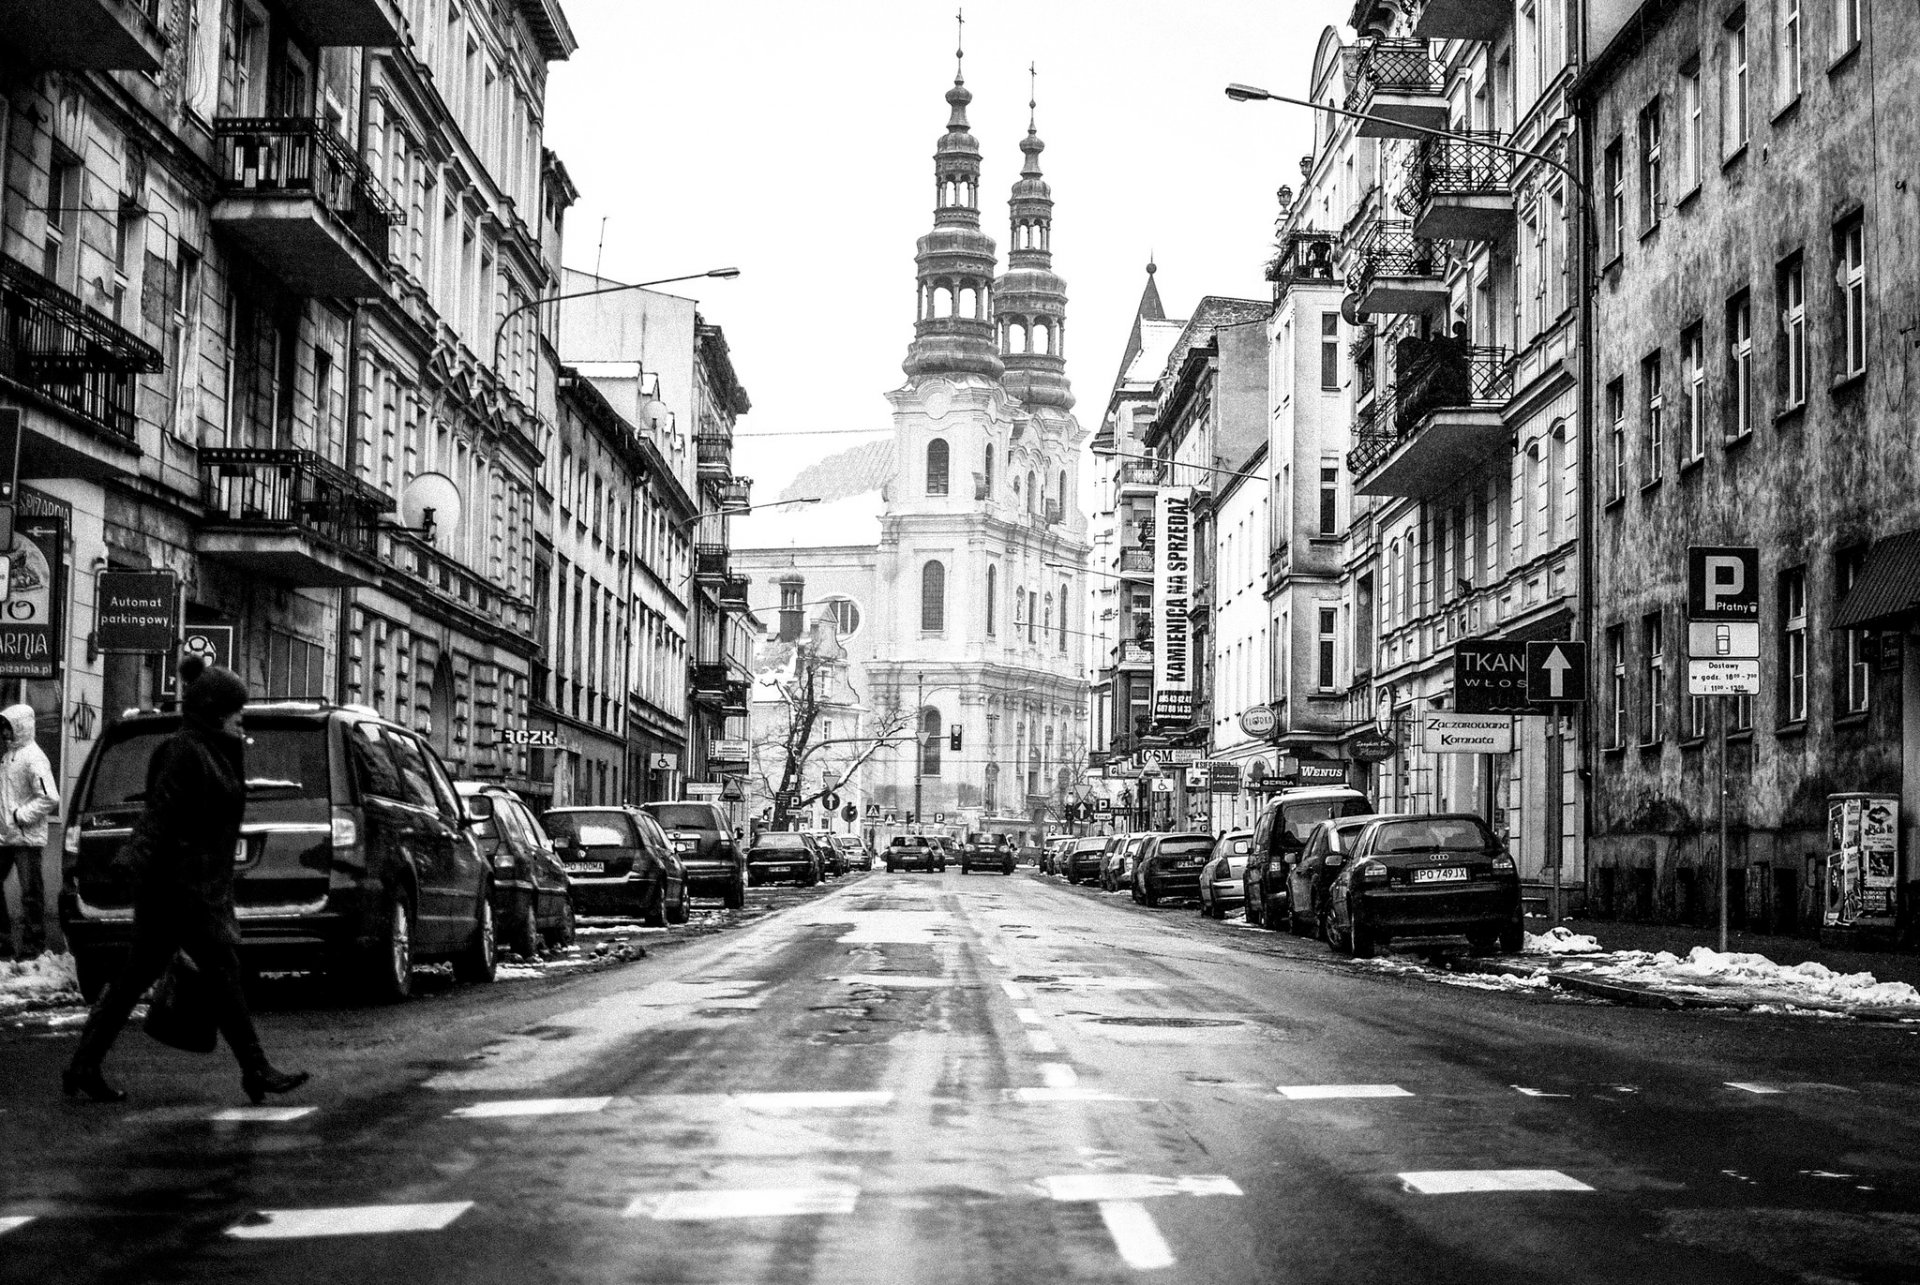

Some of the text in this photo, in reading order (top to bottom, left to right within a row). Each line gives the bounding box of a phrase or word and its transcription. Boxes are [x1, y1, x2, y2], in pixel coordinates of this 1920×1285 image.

[1705, 556, 1744, 610] P
[1164, 498, 1189, 682] KAMIENICA NA SPRZEDAŻ
[110, 596, 162, 607] Automat
[1717, 602, 1748, 613] Płatny
[101, 613, 169, 627] parkingowy
[1461, 653, 1525, 672] TKAN
[1708, 662, 1739, 671] Dostawy
[1464, 678, 1527, 688] WŁOS
[1427, 718, 1510, 731] Zaczarowana
[1441, 734, 1495, 745] Komnata
[1143, 750, 1174, 762] GSM
[1301, 766, 1343, 777] WENUS
[1099, 800, 1108, 811] P
[1420, 868, 1466, 880] PO 749JX
